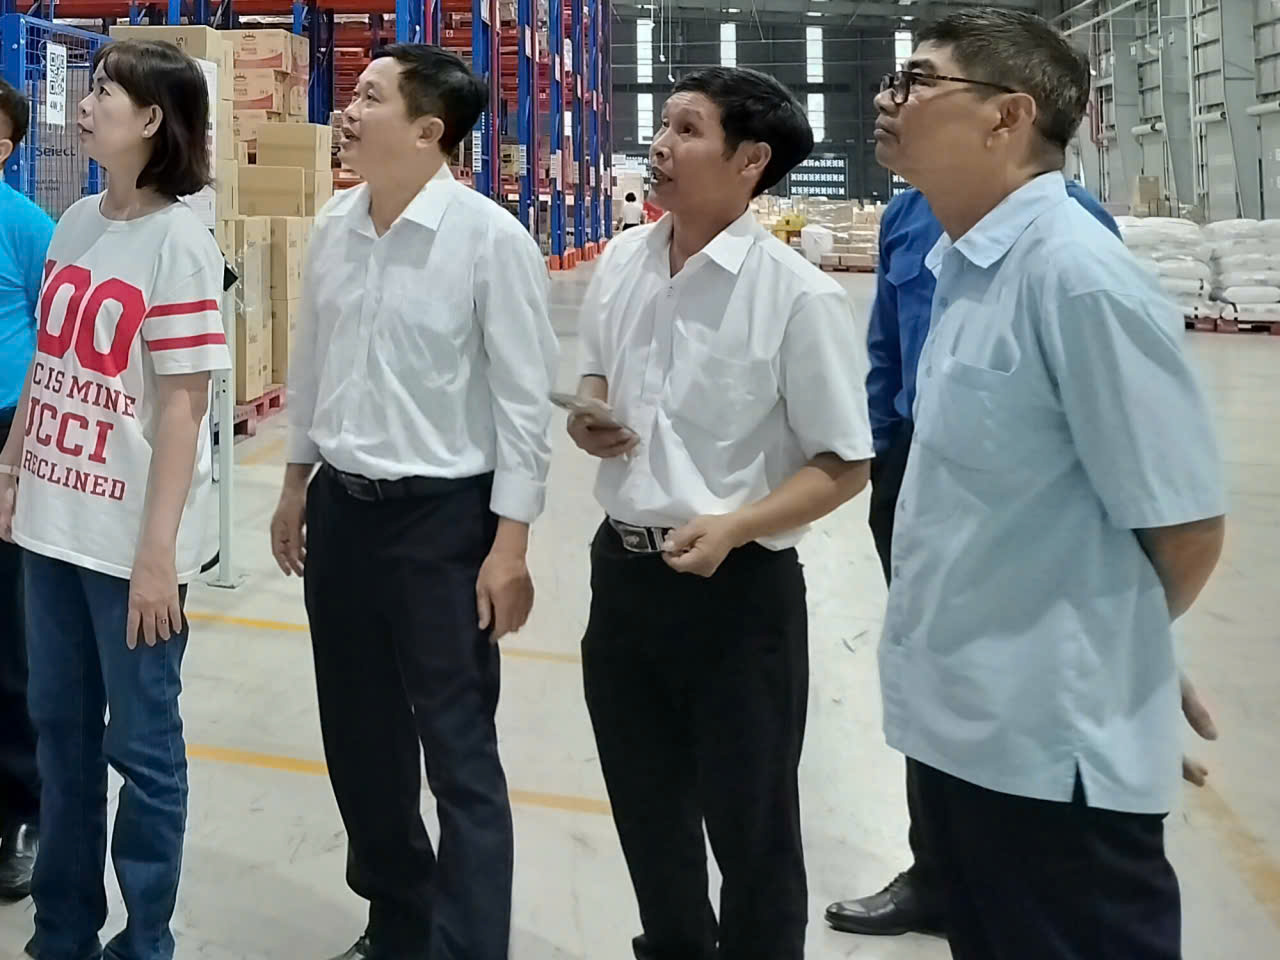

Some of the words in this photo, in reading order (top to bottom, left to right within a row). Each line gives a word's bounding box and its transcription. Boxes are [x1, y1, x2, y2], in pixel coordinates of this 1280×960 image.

[45, 368, 65, 394] IS
[66, 376, 137, 419] MINE
[23, 450, 126, 502] RECLINED
